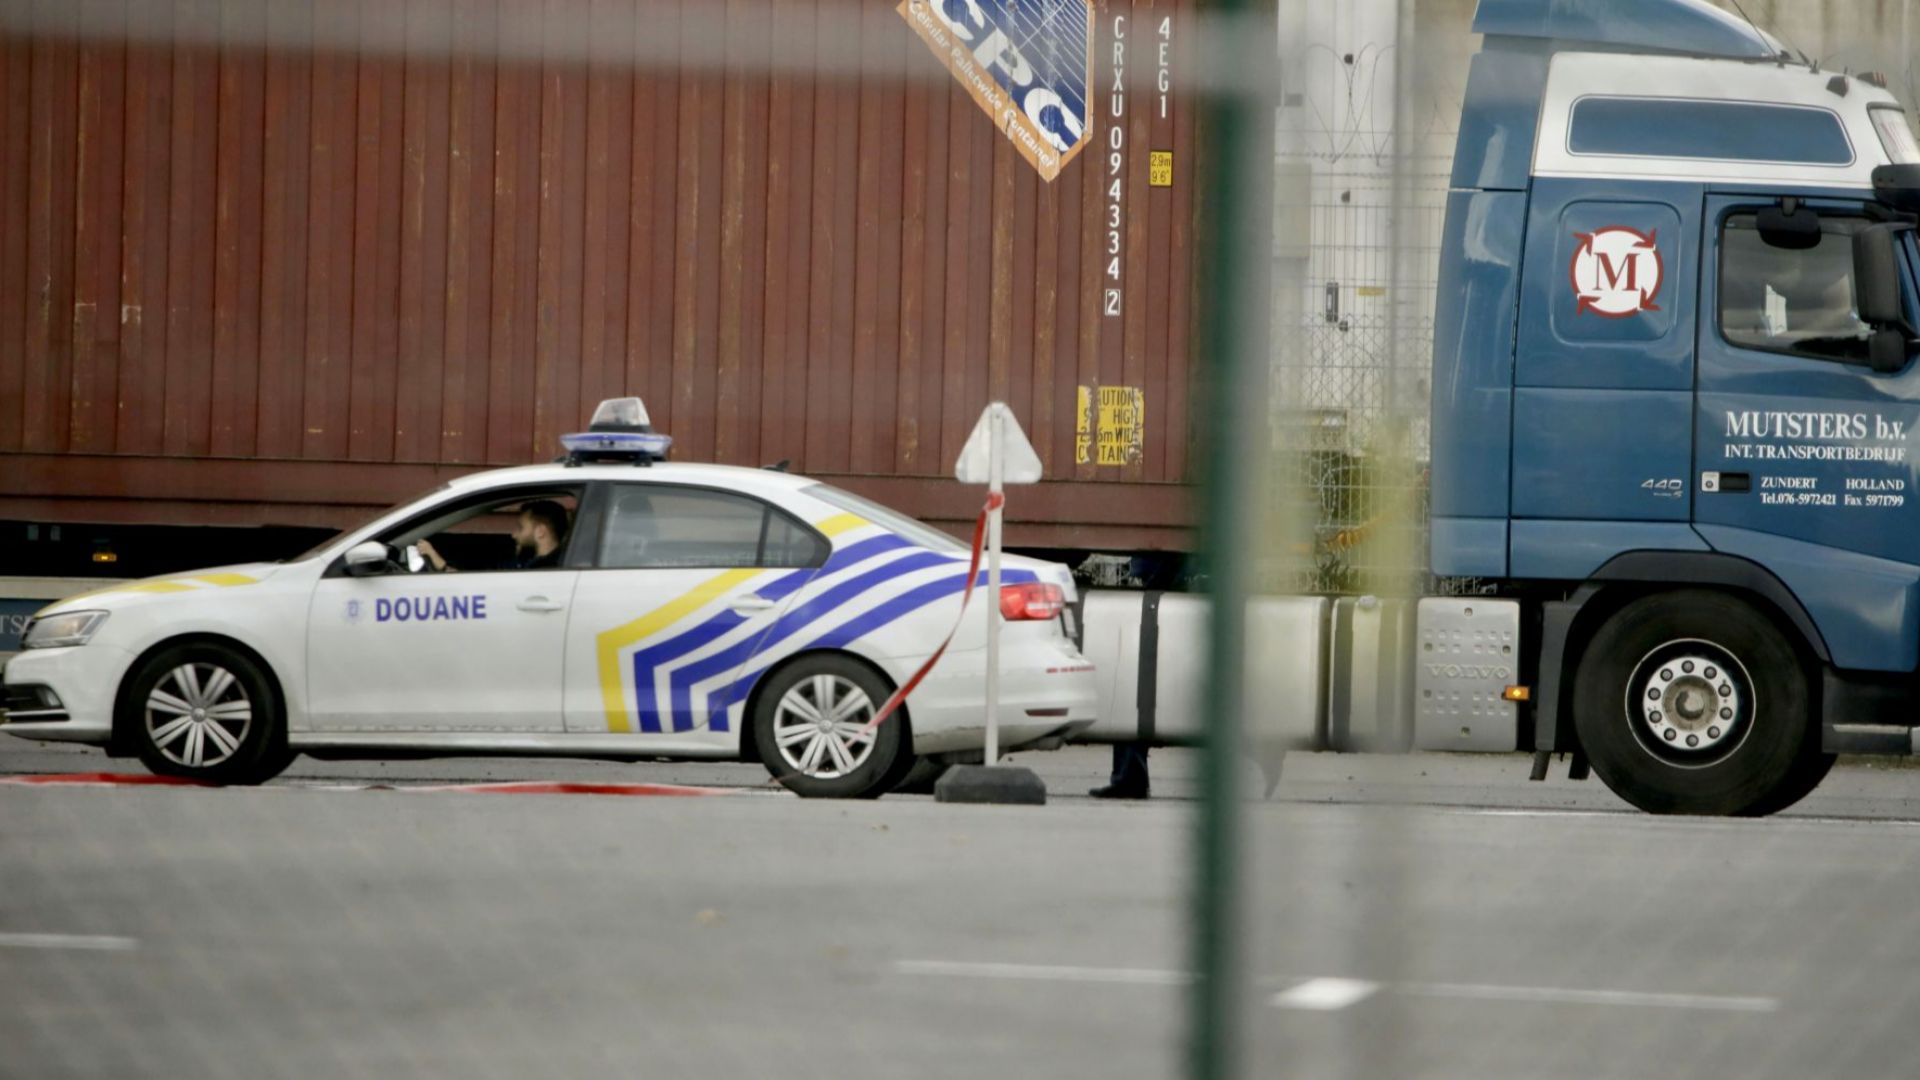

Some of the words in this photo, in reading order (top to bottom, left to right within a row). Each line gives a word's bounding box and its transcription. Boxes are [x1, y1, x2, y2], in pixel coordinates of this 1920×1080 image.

[1112, 15, 1125, 117] CRXU
[1158, 16, 1171, 118] 4EG1
[951, 47, 1003, 110] Palletwide
[1003, 109, 1056, 168] Container
[1107, 126, 1123, 280] 094334
[1592, 252, 1640, 291] M
[1725, 411, 1867, 440] MUTSTERS
[1876, 414, 1906, 440] b.v.
[1725, 444, 1753, 458] INT.
[1756, 444, 1905, 461] TRANSPORTBEDRIJF
[1641, 479, 1682, 489] 440
[1761, 477, 1817, 489] ZUNDERT
[1846, 479, 1904, 490] HOLLAND
[1844, 494, 1862, 506] Fax
[376, 595, 487, 622] DOUANE
[1424, 663, 1511, 679] VOLVO
